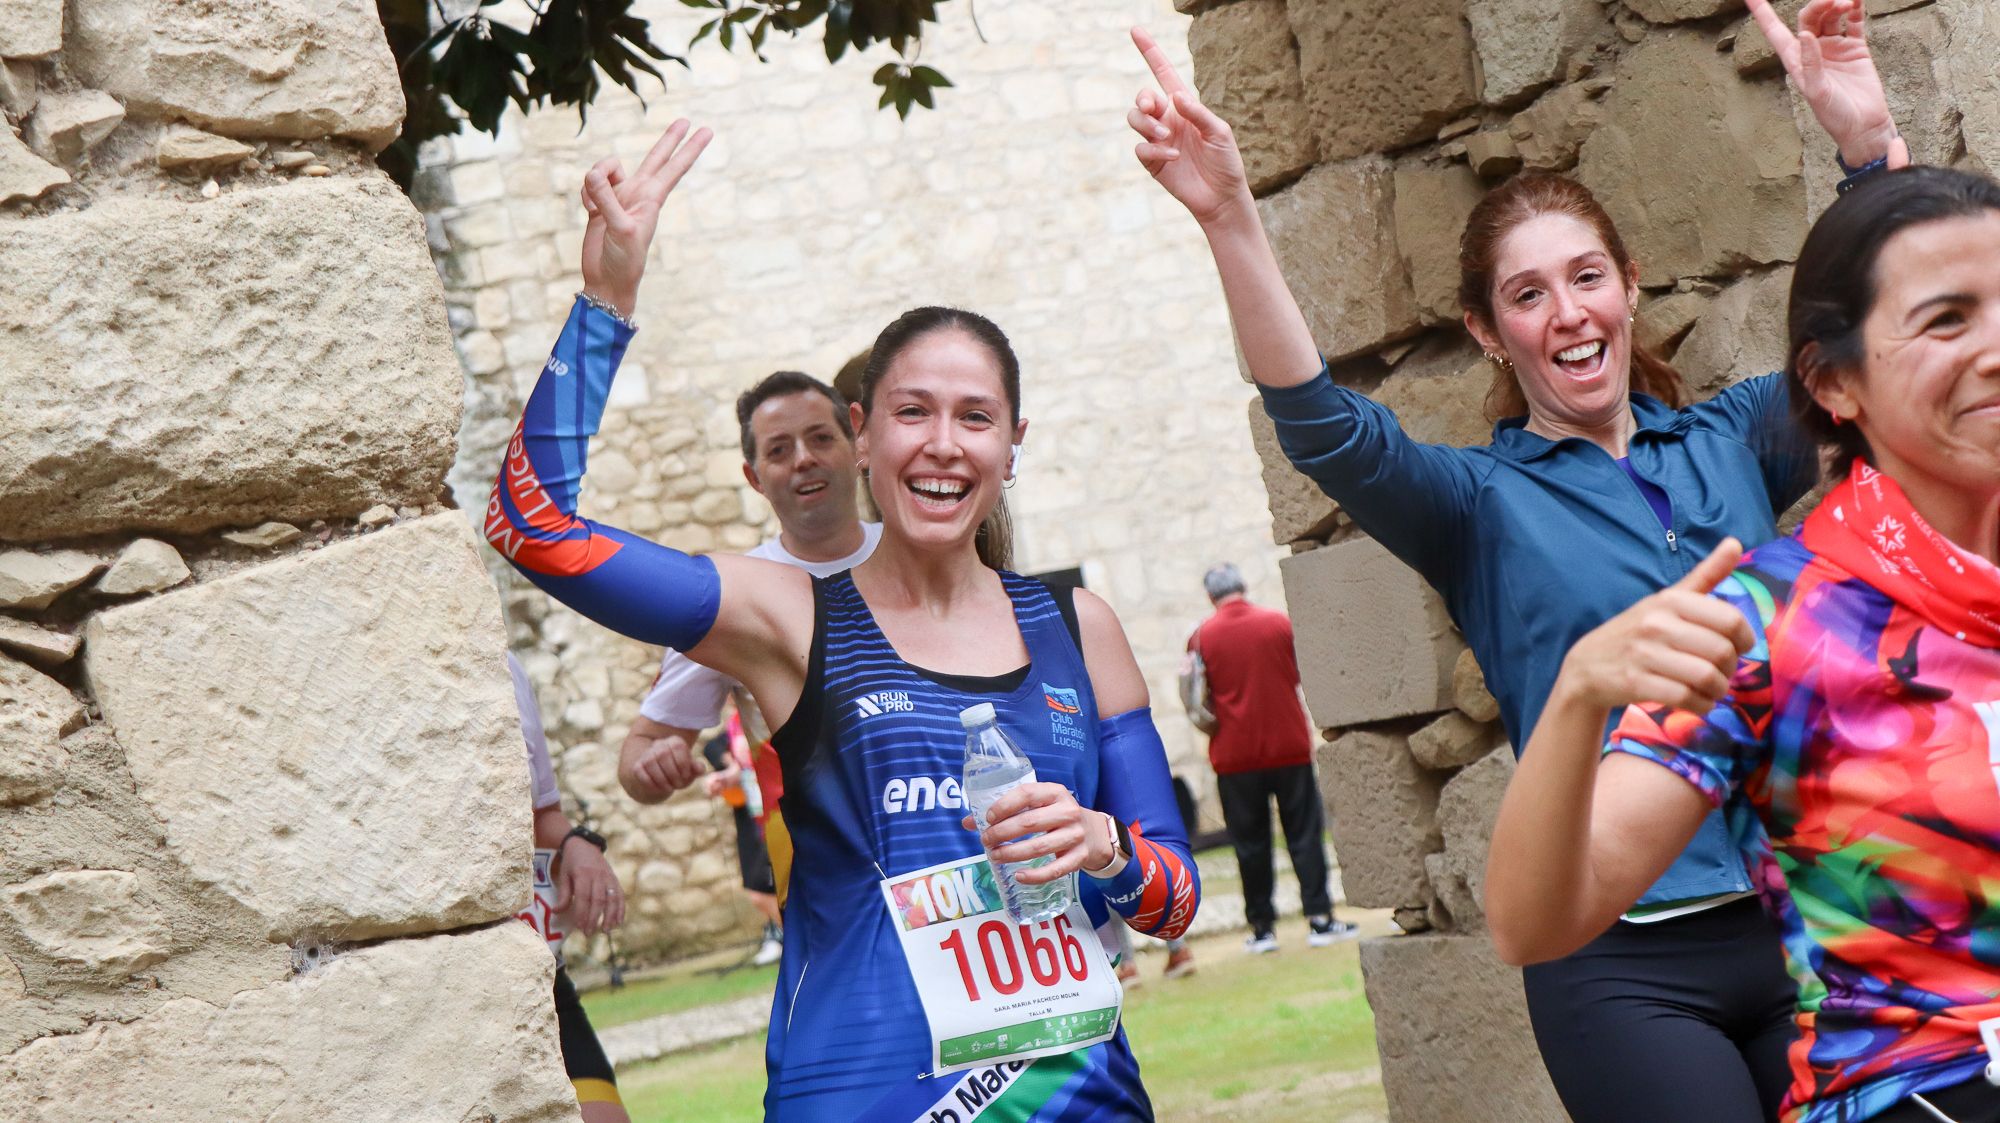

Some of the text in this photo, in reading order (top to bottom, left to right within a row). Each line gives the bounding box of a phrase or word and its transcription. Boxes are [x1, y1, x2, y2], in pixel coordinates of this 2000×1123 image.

[880, 691, 909, 702] RUN
[885, 700, 914, 713] PRO
[1050, 711, 1074, 726] Club
[1051, 722, 1087, 741] Maratón
[1052, 733, 1085, 752] Lucena
[911, 866, 987, 922] 10K
[939, 912, 1089, 1002] 1066
[993, 991, 1080, 1014] SARA MARIA PACHECO MOLINA
